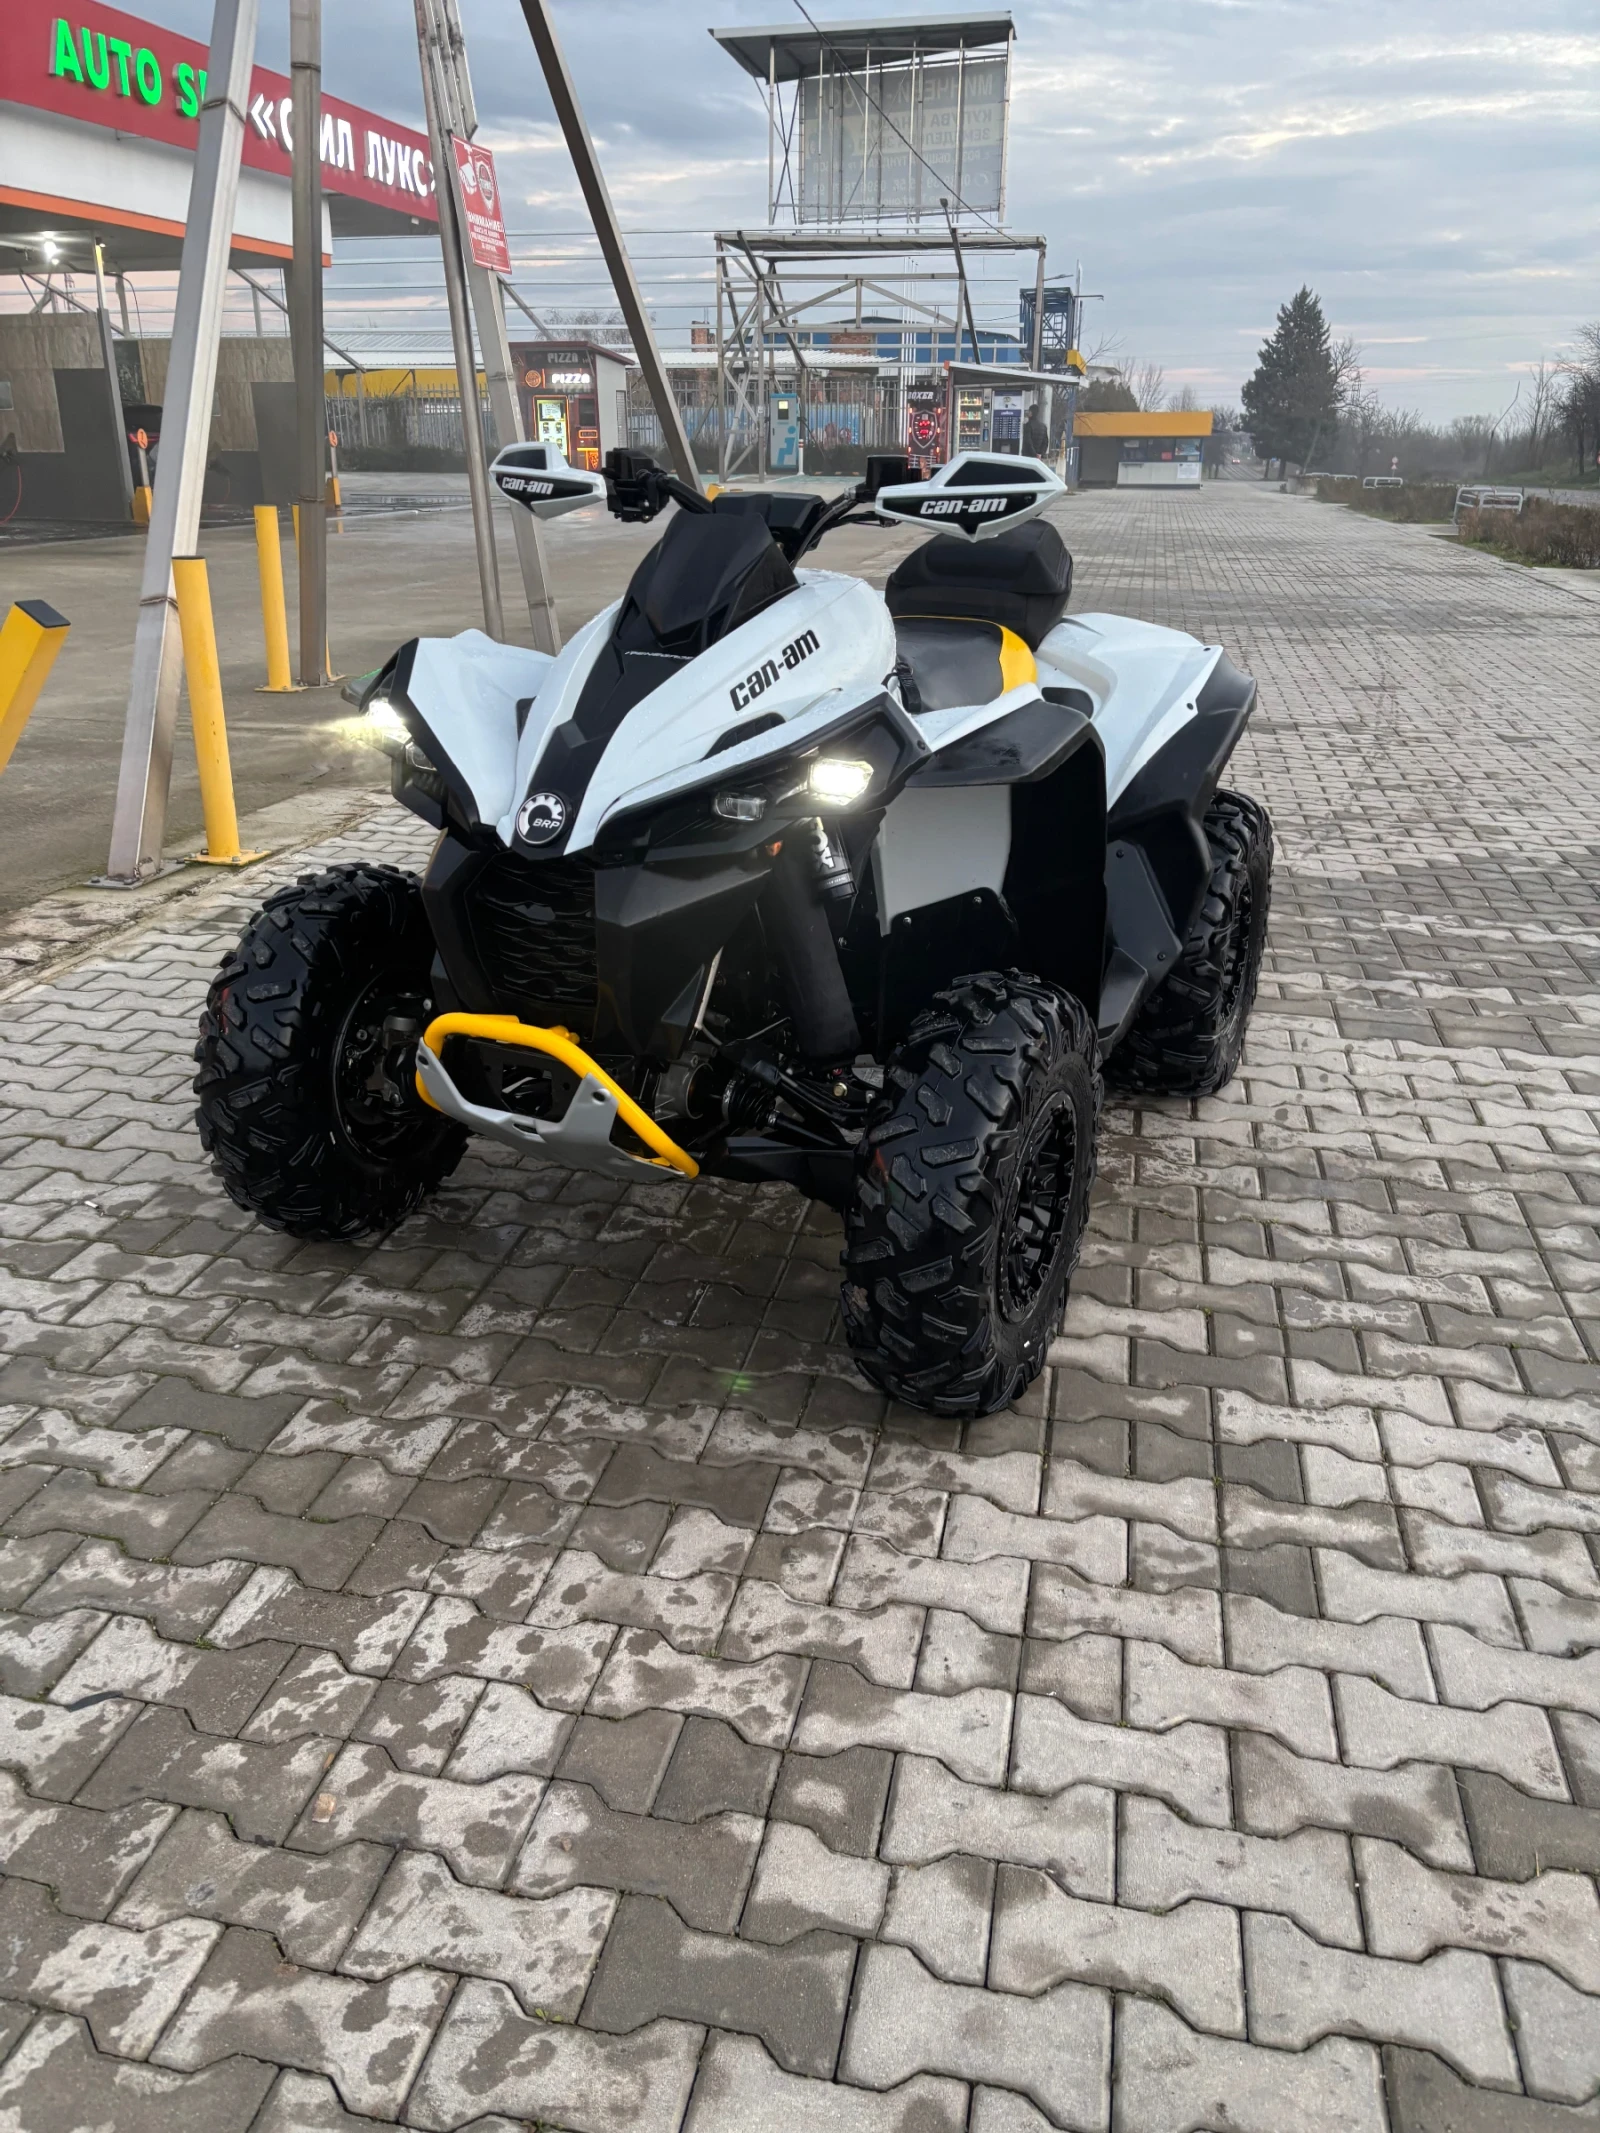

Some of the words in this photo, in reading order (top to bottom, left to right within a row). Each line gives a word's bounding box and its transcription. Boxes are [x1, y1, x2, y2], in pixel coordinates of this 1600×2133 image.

[52, 18, 162, 105] AUTO
[251, 94, 354, 171] «СИЛ
[547, 352, 578, 364] PIZZA
[551, 373, 591, 384] PIZZA
[501, 476, 554, 495] can-am
[920, 498, 1008, 515] can-am
[729, 629, 821, 712] can-am
[532, 818, 561, 829] BRP
